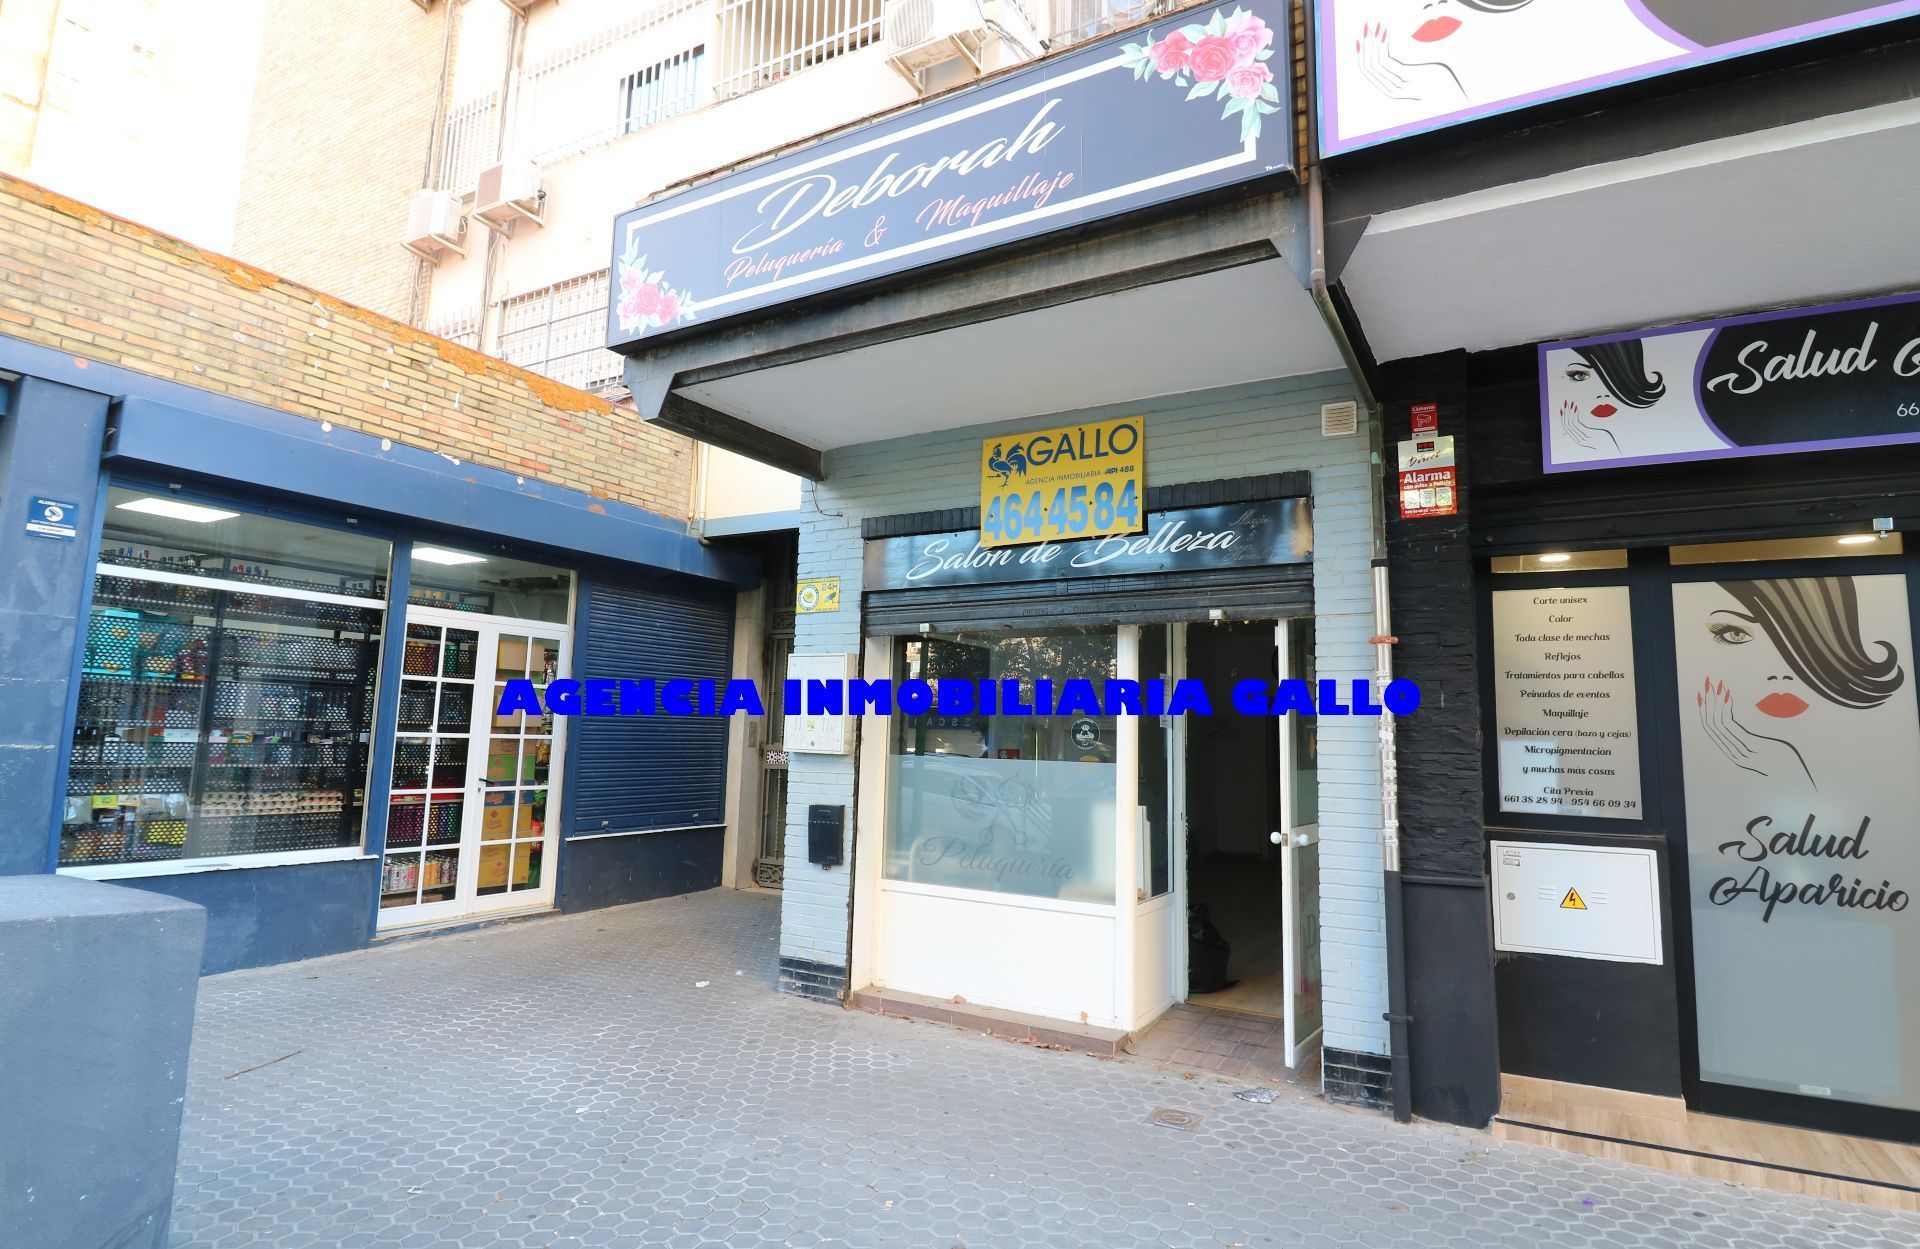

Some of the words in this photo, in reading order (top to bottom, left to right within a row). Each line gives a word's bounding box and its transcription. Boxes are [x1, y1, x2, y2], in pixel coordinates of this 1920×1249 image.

[733, 98, 1066, 251] Deborah
[724, 236, 845, 289] Peluquería
[864, 215, 887, 248] &
[916, 170, 1074, 232] Maquillaje
[1706, 321, 1879, 395] Salud
[1026, 423, 1138, 467] GALLO
[1025, 475, 1055, 486] AGENCIA
[1056, 470, 1101, 482] INMOBILIARIA
[1103, 466, 1118, 476] API
[1119, 465, 1135, 474] 488
[1403, 471, 1451, 484] Alarma
[1018, 541, 1064, 566] de
[1070, 519, 1241, 569] Belleza
[821, 582, 838, 592] 24H
[1533, 596, 1558, 605] Corte
[1559, 595, 1588, 604] unisex
[1548, 614, 1574, 623] Color
[1514, 633, 1536, 642] Toda
[1537, 633, 1561, 642] clase
[1562, 633, 1574, 642] de
[1575, 632, 1611, 641] mechas
[1544, 652, 1582, 662] Reflejos
[1504, 670, 1562, 679] Tratamientos
[1563, 672, 1586, 681] para
[1587, 670, 1625, 679] cabellos
[1519, 689, 1561, 698] Peinados
[1562, 690, 1574, 698] de
[1576, 690, 1611, 699] eventos
[1542, 708, 1589, 719] Maquillaje
[1503, 726, 1550, 737] Depilación
[1552, 729, 1573, 737] cera
[1574, 729, 1598, 738] (bozo
[1607, 730, 1632, 739] cejas)
[1522, 766, 1529, 774] y
[1530, 765, 1566, 774] muchas
[1588, 768, 1616, 776] cosas
[1543, 786, 1562, 795] Cita
[1563, 787, 1595, 796] Previa
[1504, 795, 1520, 803] 661
[1521, 795, 1534, 804] 38
[1535, 796, 1548, 804] 28
[1550, 797, 1563, 805] 94
[1571, 798, 1590, 806] 954
[1592, 799, 1605, 807] 66
[1607, 799, 1621, 808] 09
[1623, 800, 1637, 809] 34
[1718, 813, 1871, 862] Salud
[919, 835, 1076, 881] Peluquería
[1709, 866, 1909, 924] Aparicio
